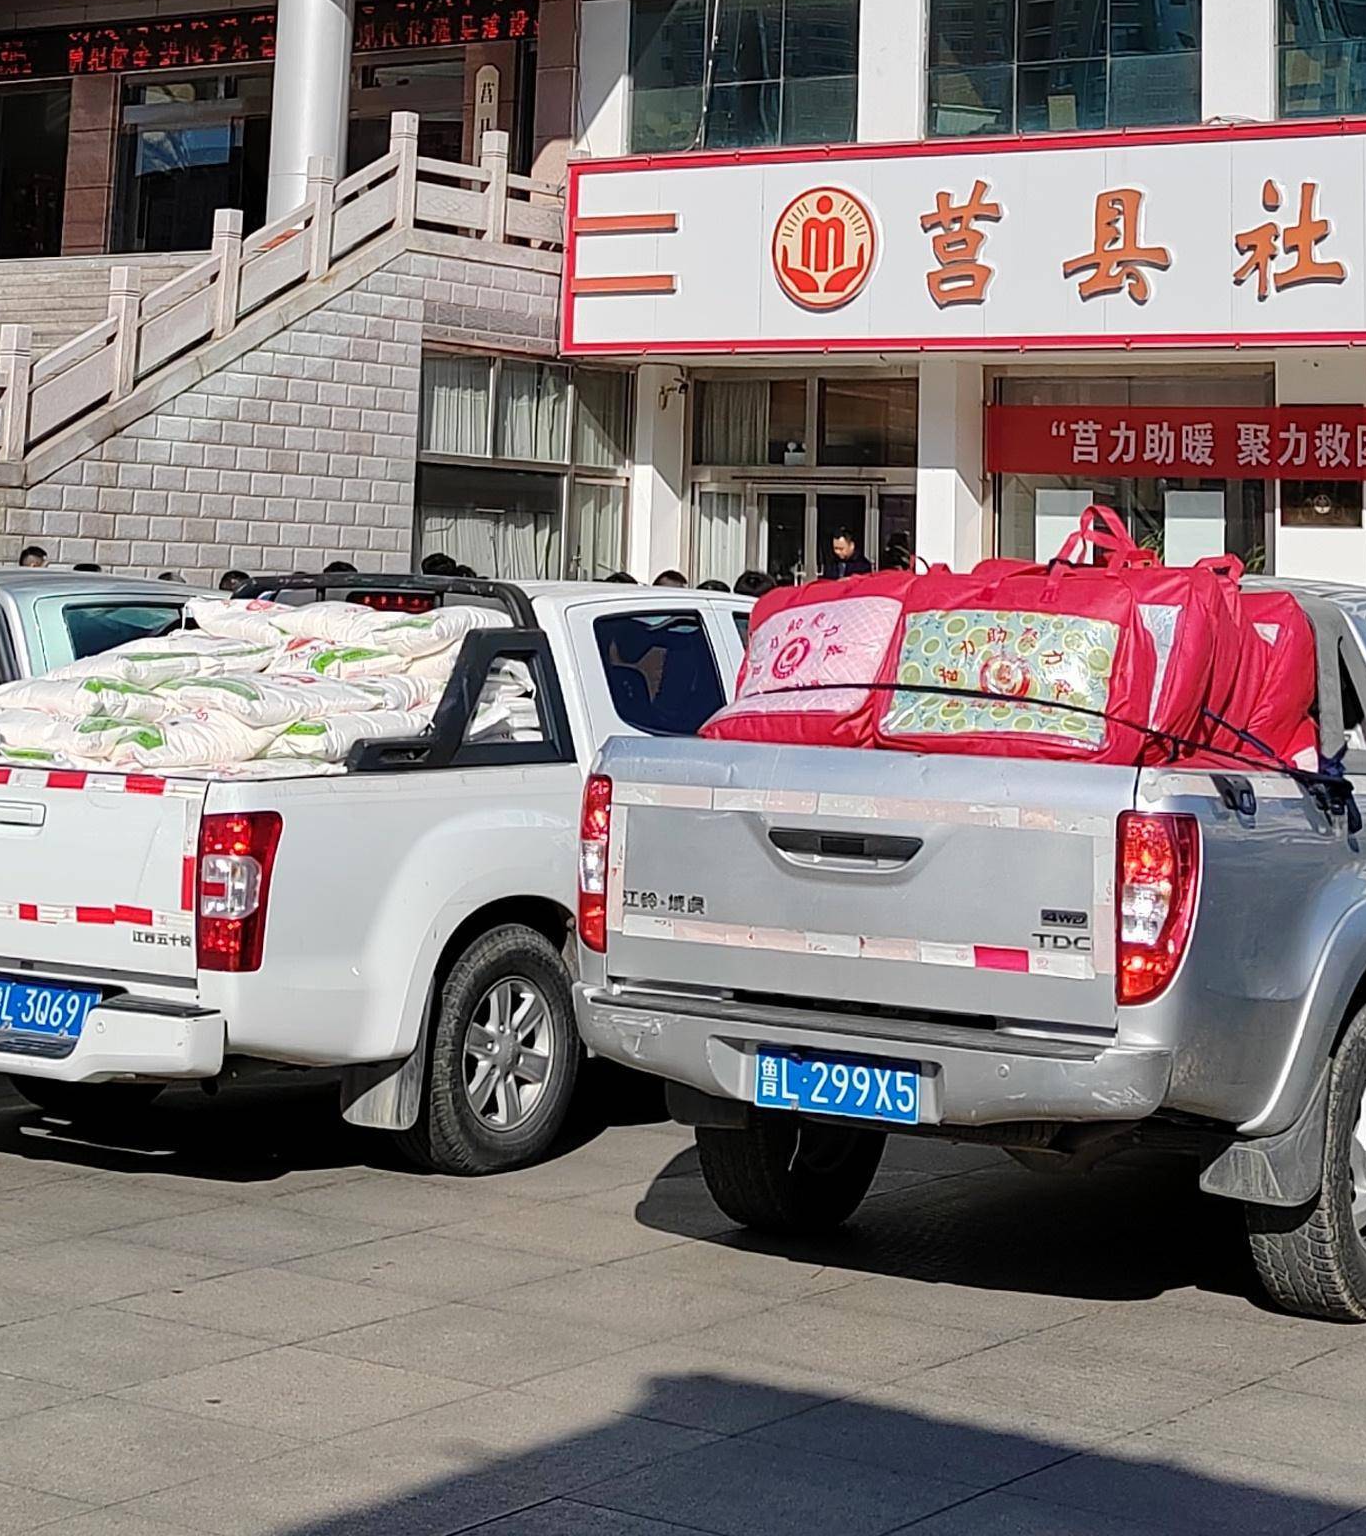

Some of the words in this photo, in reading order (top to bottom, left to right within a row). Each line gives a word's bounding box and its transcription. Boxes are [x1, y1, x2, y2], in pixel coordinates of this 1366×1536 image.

[1043, 912, 1088, 925] 4WD
[132, 930, 192, 947] 江西五十铃
